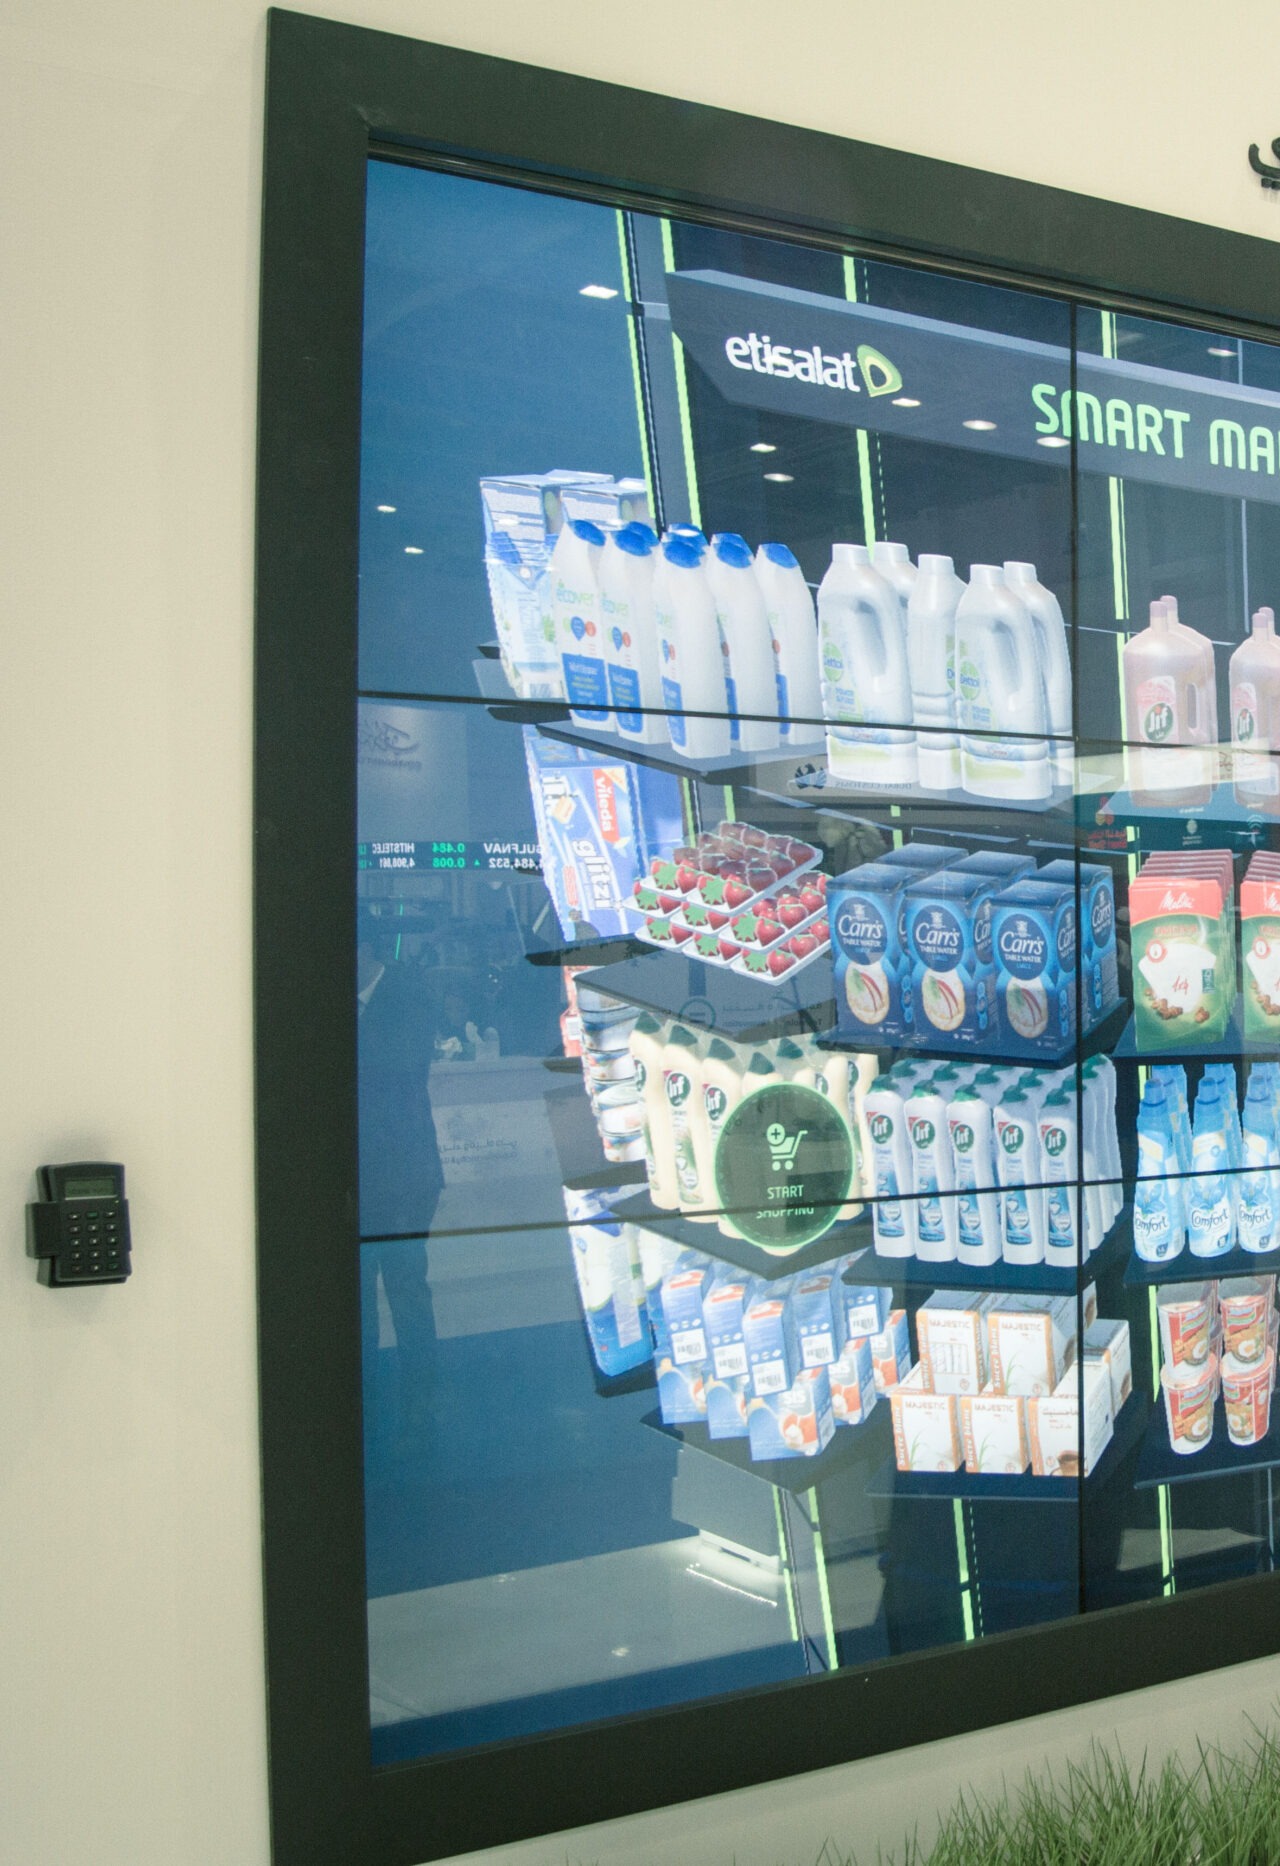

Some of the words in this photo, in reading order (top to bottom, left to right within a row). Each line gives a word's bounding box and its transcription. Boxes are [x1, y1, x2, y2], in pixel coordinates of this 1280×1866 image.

[725, 332, 860, 393] etisalat
[1031, 383, 1190, 459] SMART
[838, 914, 884, 939] Carr's
[915, 922, 960, 947] Carr's
[1000, 931, 1045, 955] Carr's
[767, 1184, 804, 1200] START
[1191, 1208, 1230, 1232] Comfort
